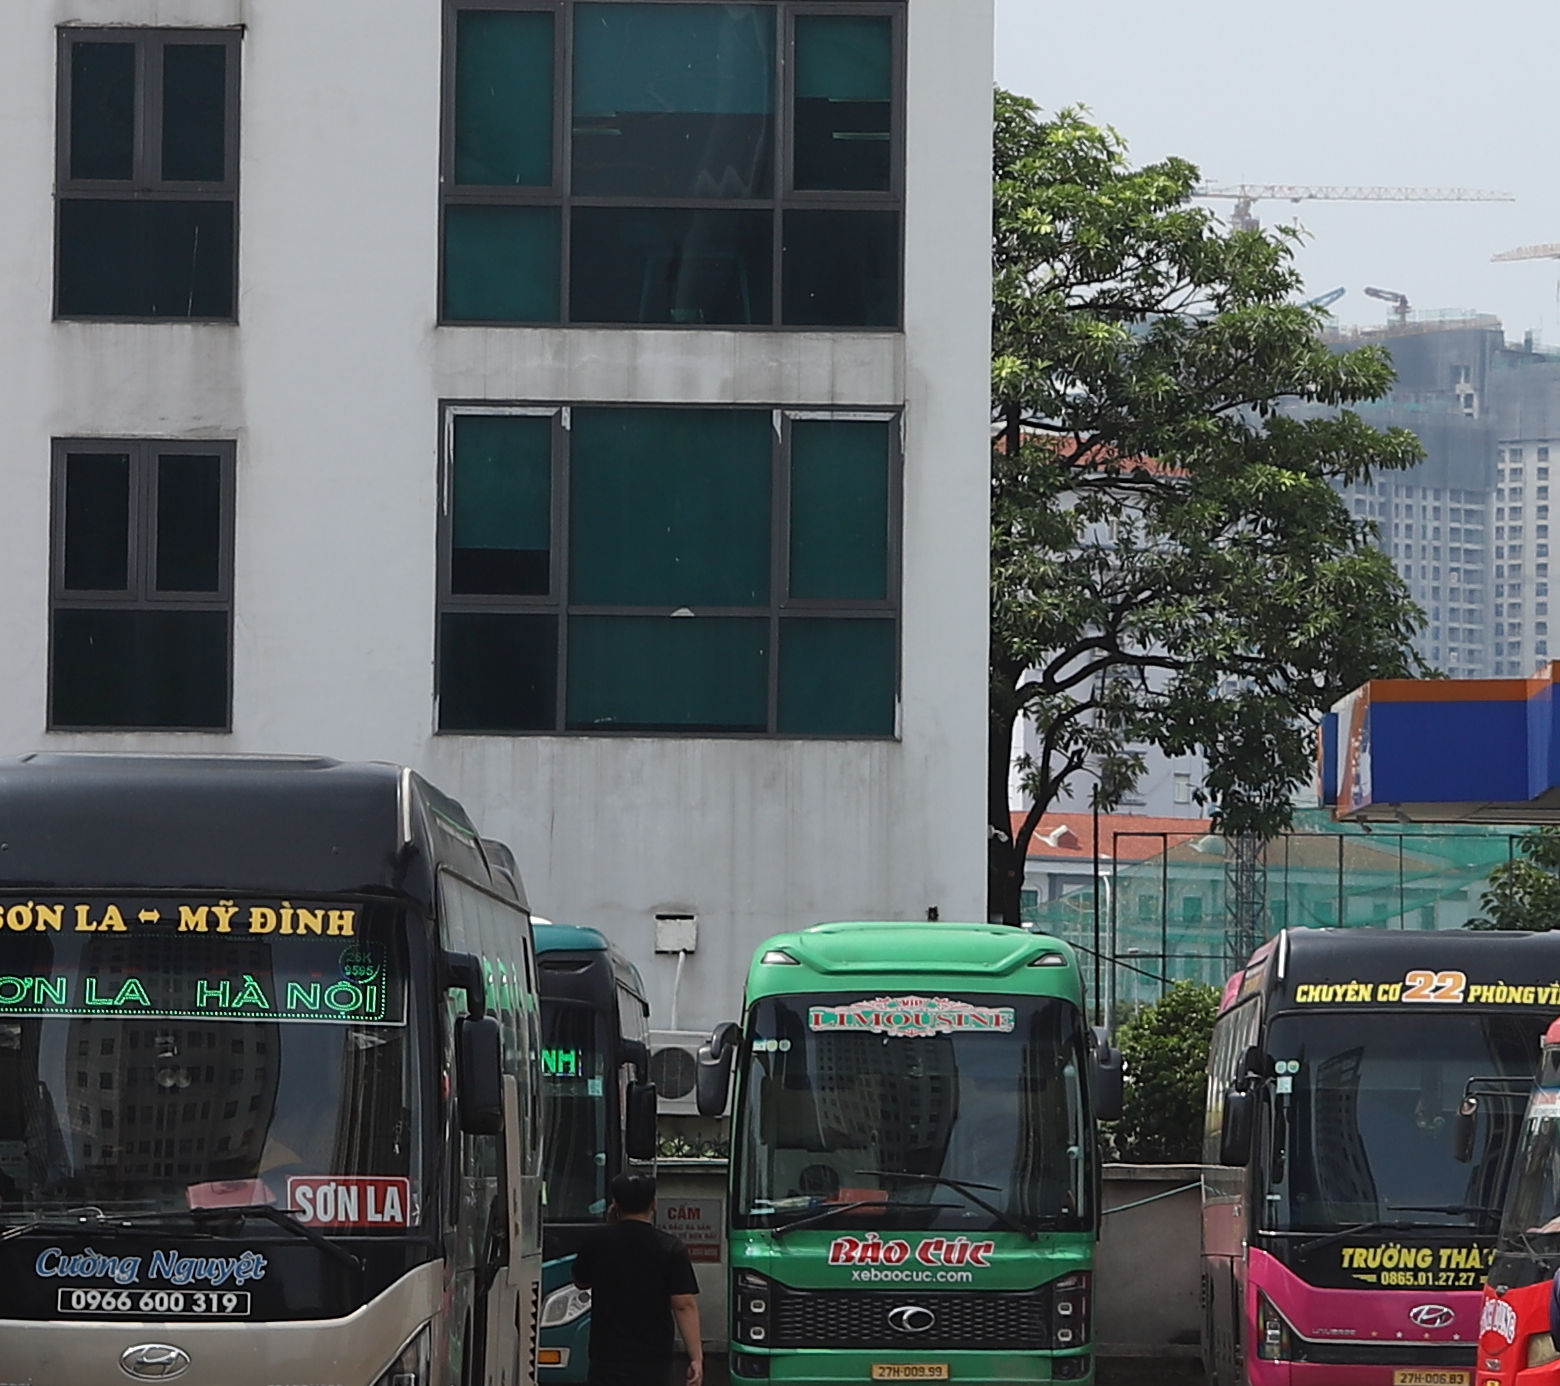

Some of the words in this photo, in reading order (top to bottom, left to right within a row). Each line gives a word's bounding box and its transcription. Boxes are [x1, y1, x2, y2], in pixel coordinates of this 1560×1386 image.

[74, 904, 128, 933] LA
[177, 900, 240, 934] MỸ
[248, 901, 356, 937] ĐÌNH
[83, 977, 152, 1007] LA
[195, 975, 270, 1010] HÀ
[286, 979, 378, 1015] NỘI
[1295, 980, 1373, 1004] CHUYÊN
[1376, 981, 1403, 1003] CƠ
[1401, 970, 1467, 1004] 22
[1467, 980, 1536, 1004] PHÒNG
[811, 1011, 1016, 1029] LIMOUSINE
[293, 1181, 363, 1223] SƠN
[366, 1184, 404, 1224] LA
[827, 1231, 910, 1265] BẢO
[915, 1236, 995, 1267] CÚC
[1341, 1242, 1433, 1269] TRƯỜNG
[35, 1246, 143, 1285] Cường
[148, 1248, 268, 1288] Nguyệt
[851, 1267, 973, 1283] xebaocuc.com
[1380, 1271, 1476, 1286] 0865.01.27.27
[71, 1290, 139, 1312] 0966
[139, 1291, 186, 1312] 600
[191, 1292, 238, 1314] 319
[877, 1366, 943, 1378] 27H-009.99
